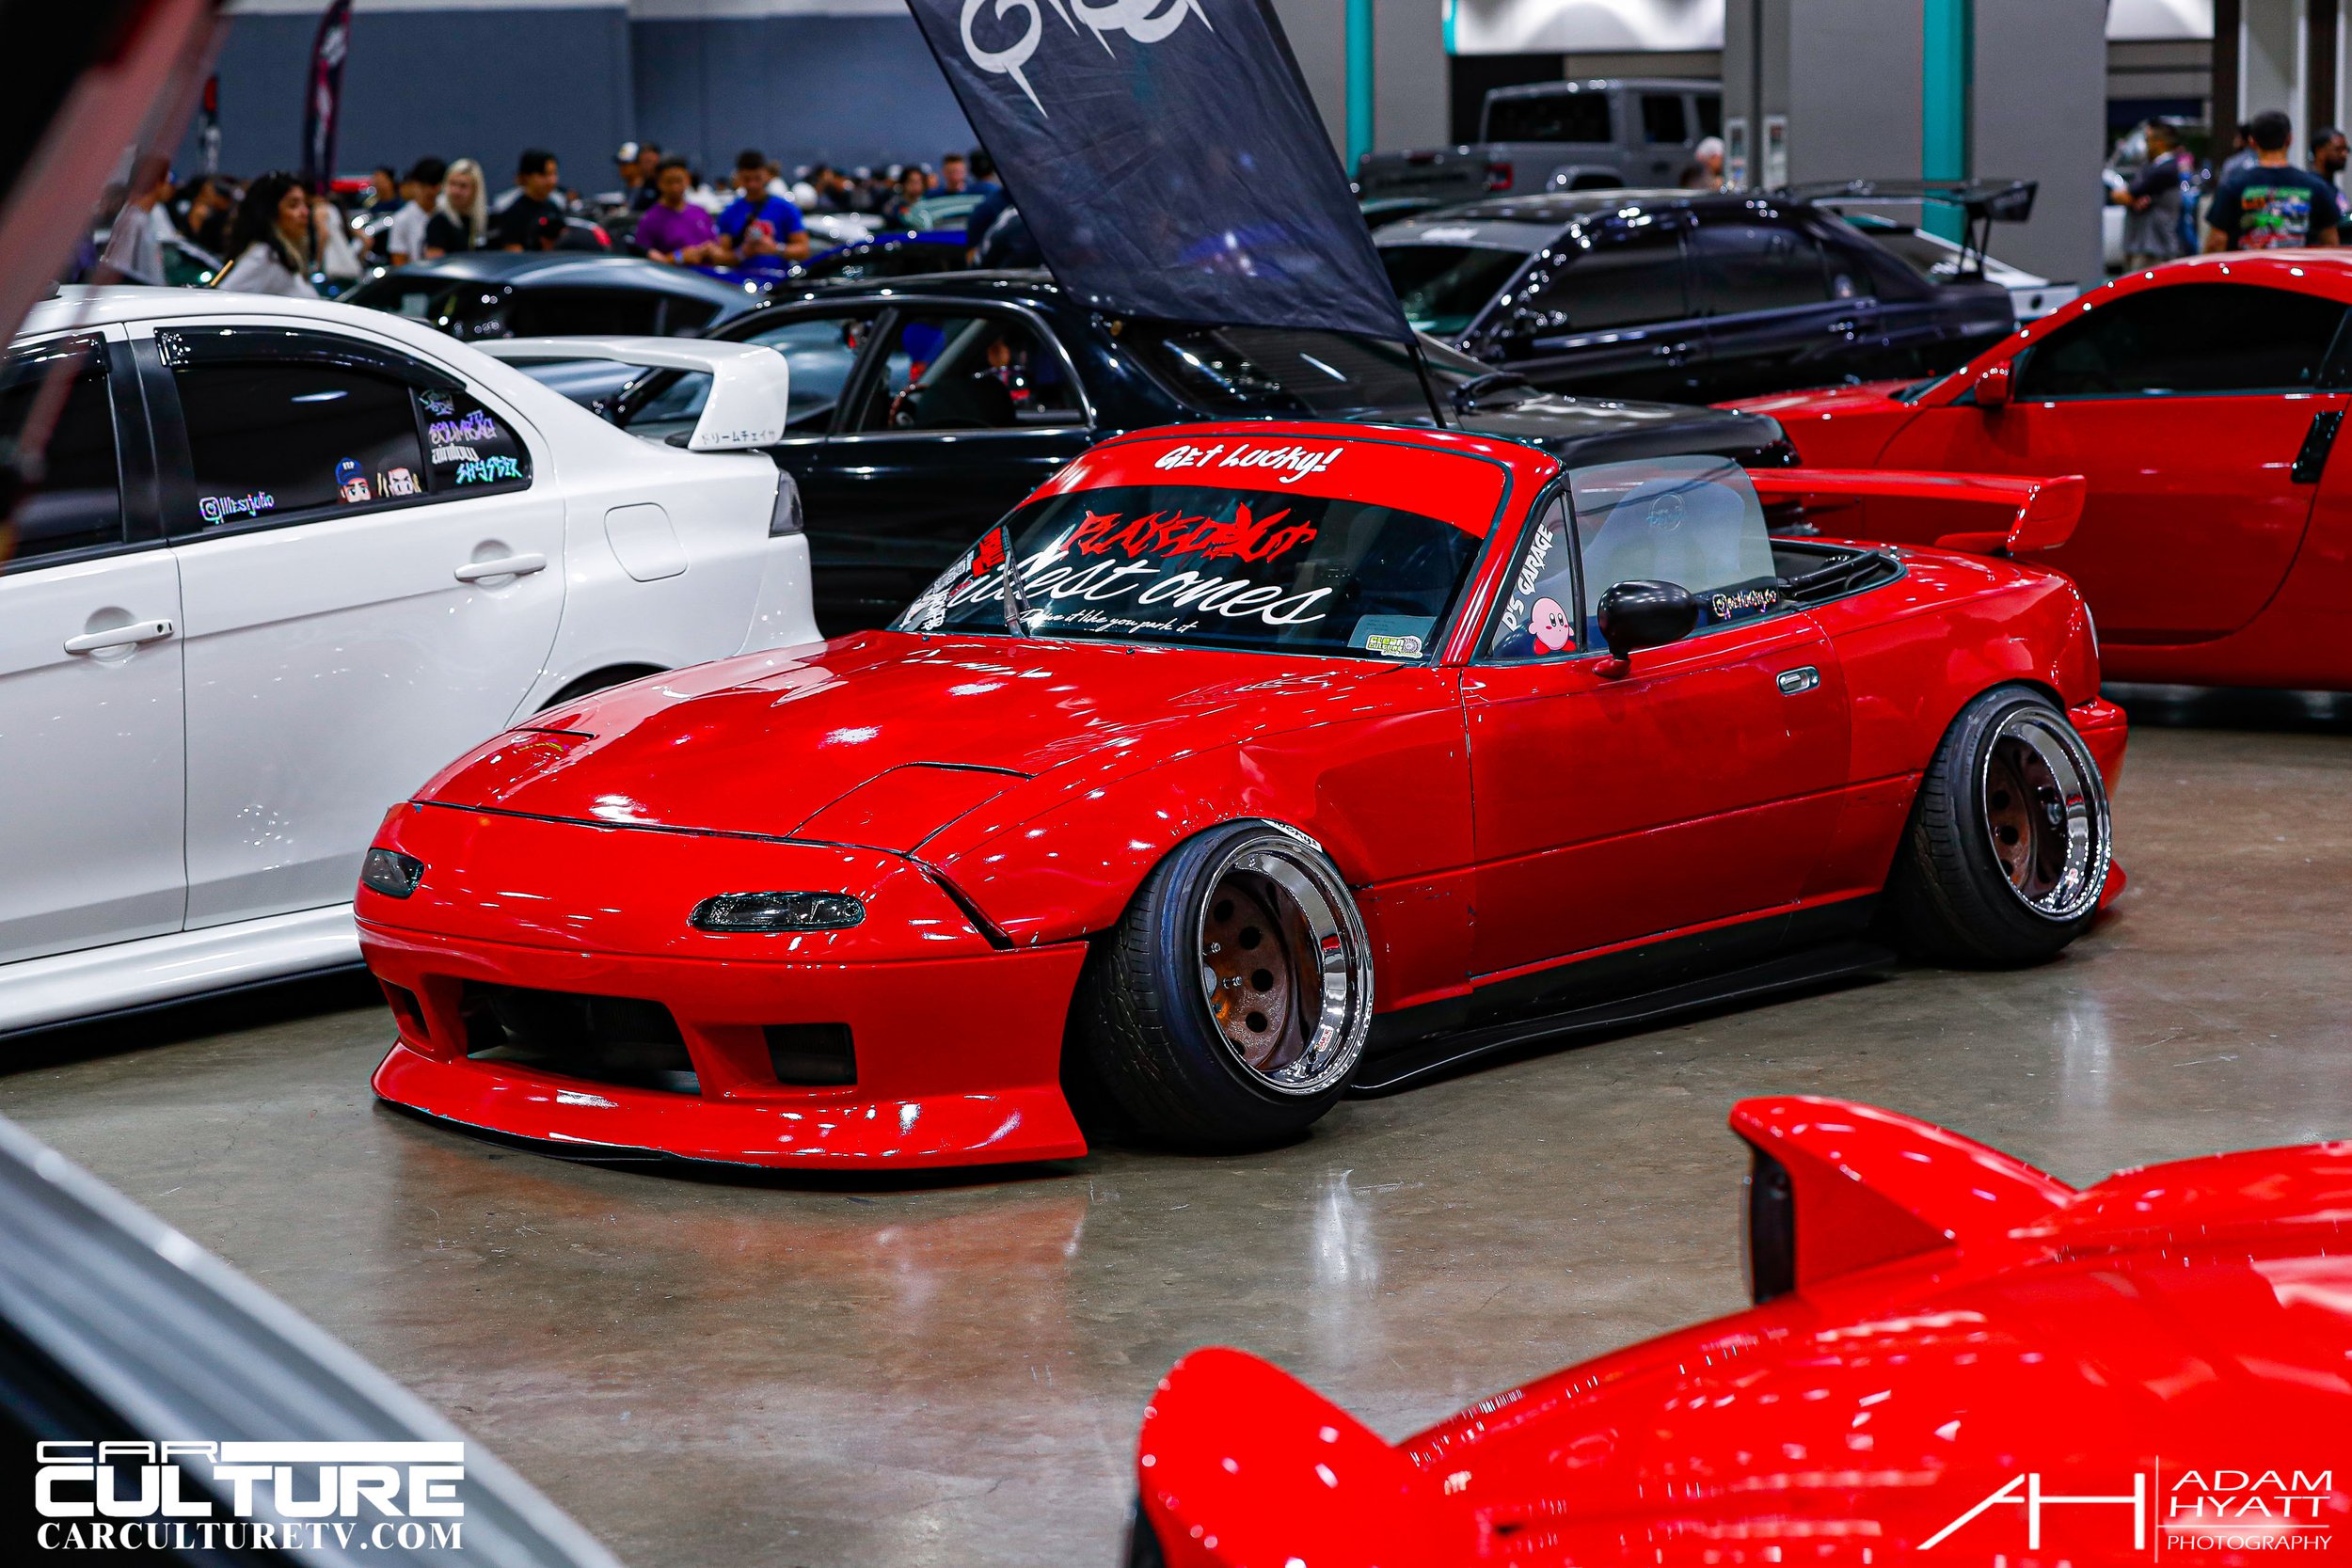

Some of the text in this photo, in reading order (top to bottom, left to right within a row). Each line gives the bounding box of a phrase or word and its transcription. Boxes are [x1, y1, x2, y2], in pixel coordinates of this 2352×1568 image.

[1518, 523, 1553, 595] GARAGE
[1064, 610, 1082, 623] it
[1078, 610, 1107, 624] like
[1095, 617, 1138, 633] you
[1129, 618, 1175, 634] park
[1176, 621, 1199, 634] it
[1138, 570, 1333, 625] ones
